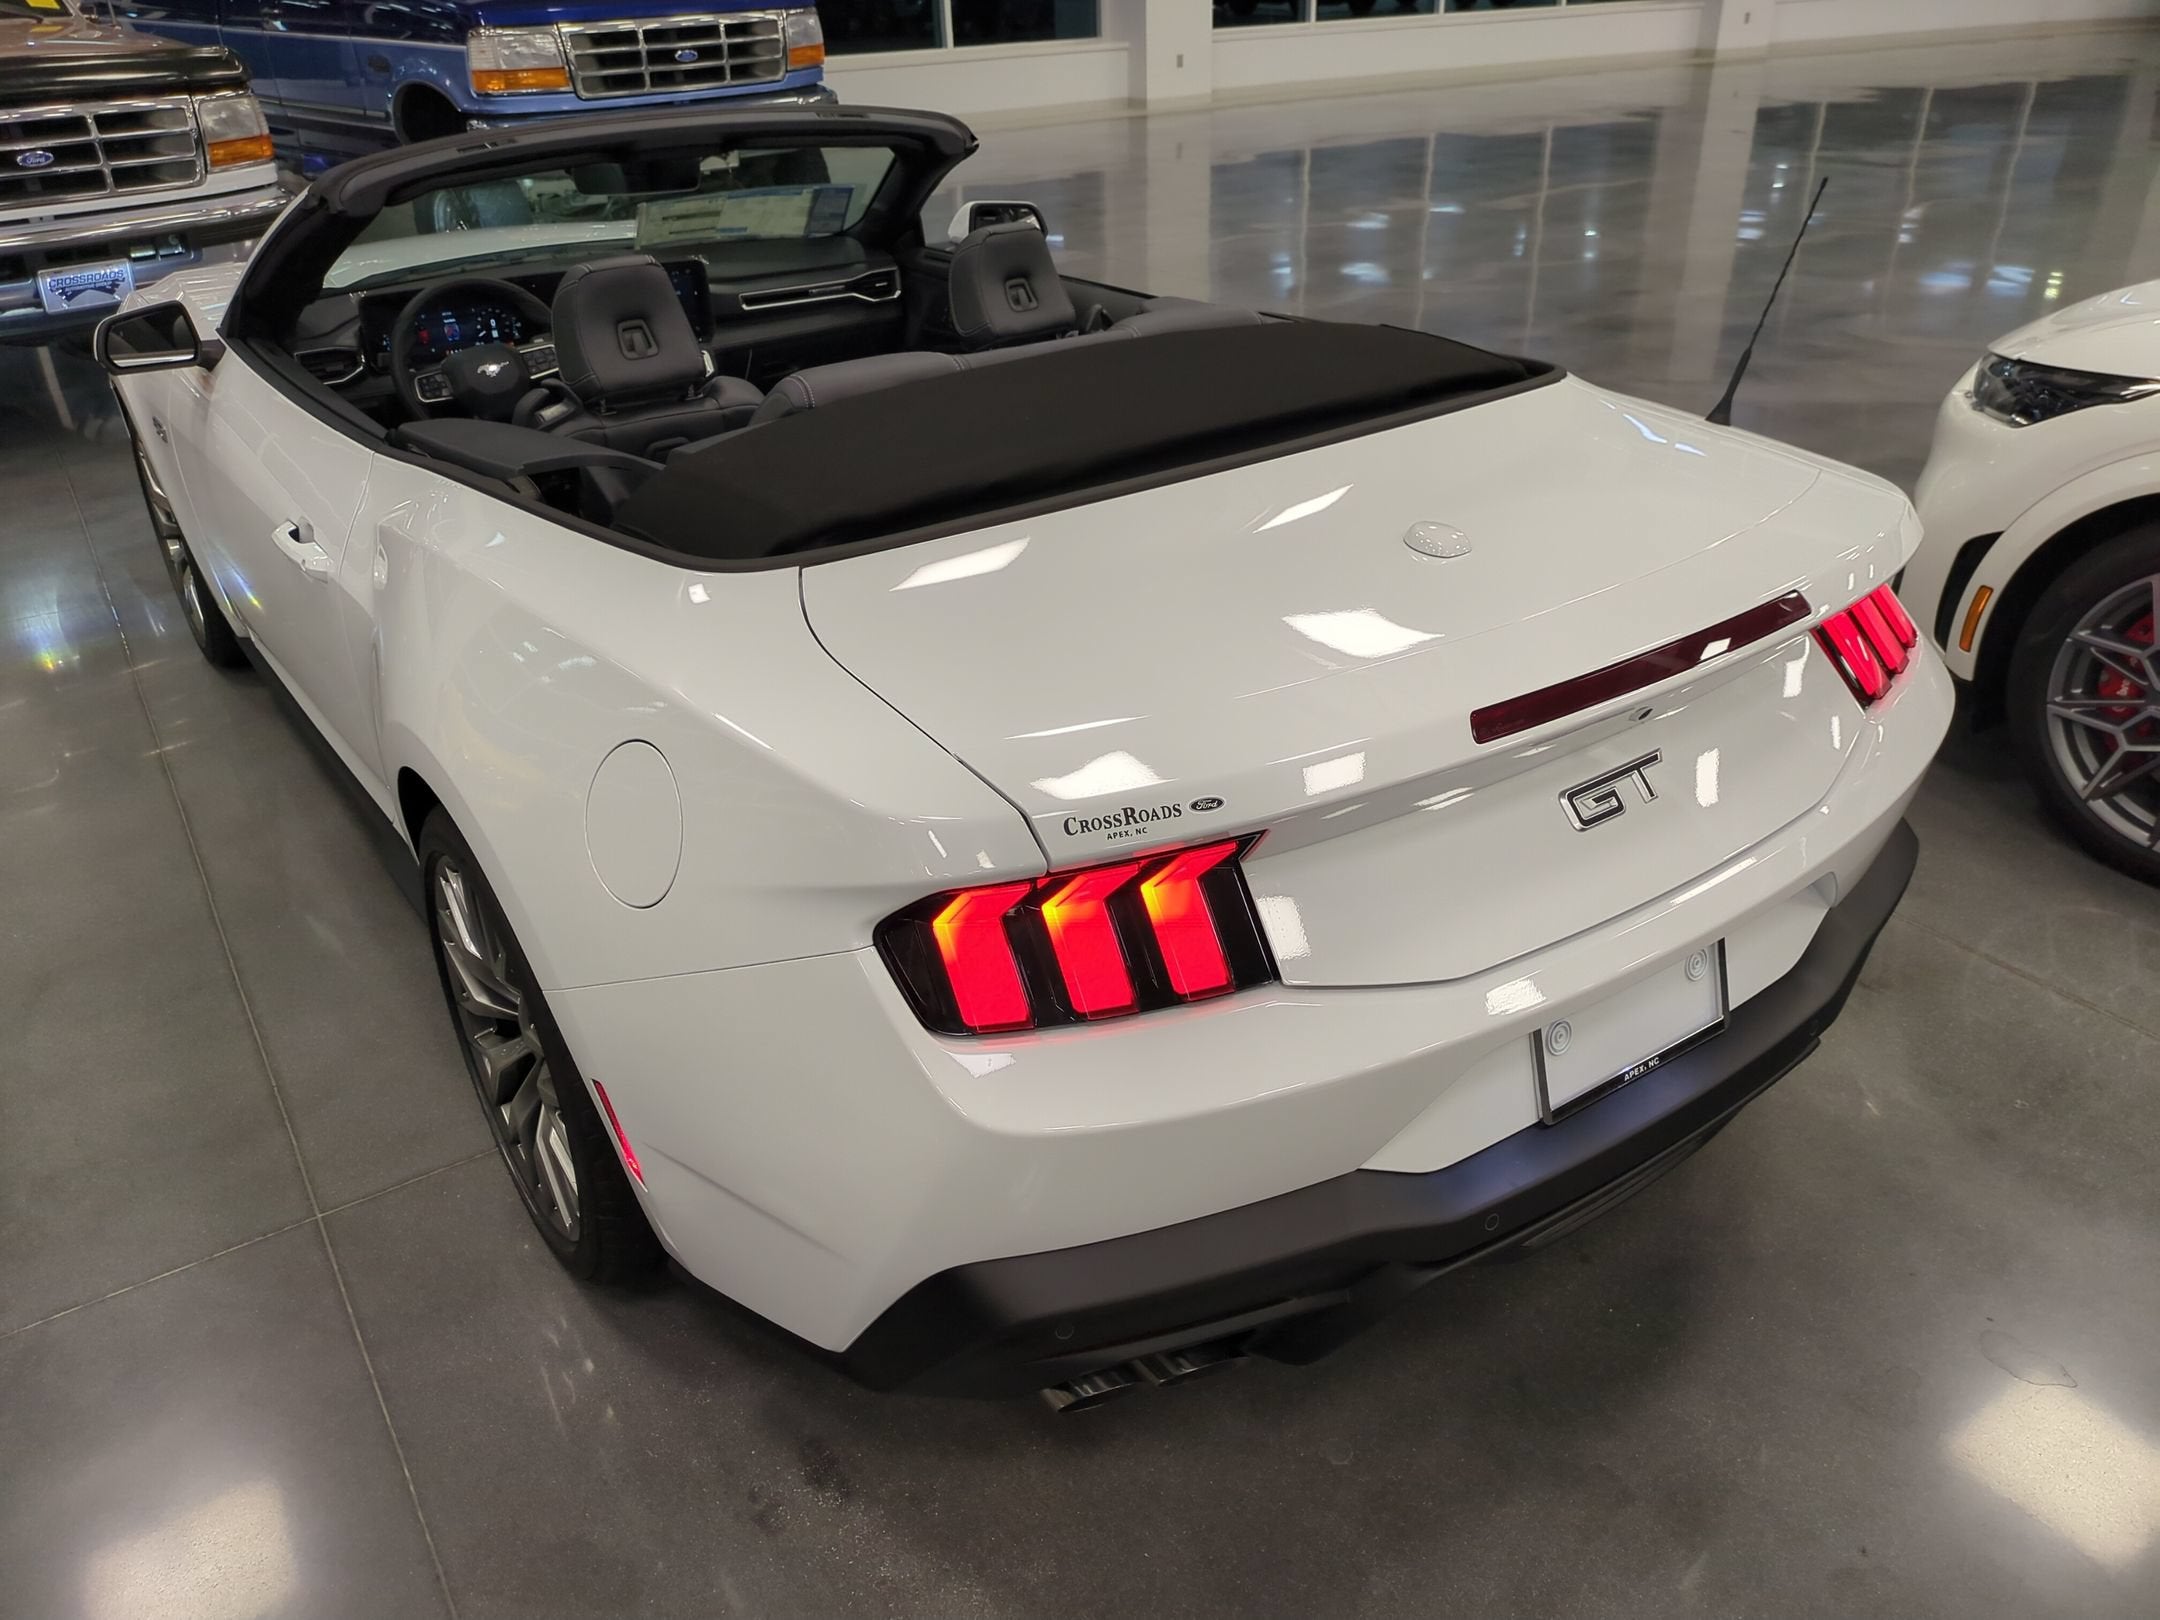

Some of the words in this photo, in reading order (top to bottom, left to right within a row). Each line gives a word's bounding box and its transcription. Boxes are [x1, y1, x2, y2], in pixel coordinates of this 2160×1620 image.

[49, 269, 124, 289] CROSSROADS
[1558, 747, 1663, 832] GT
[1107, 829, 1133, 840] APEX,
[1136, 827, 1148, 835] NC
[1624, 1065, 1647, 1082] APEX,
[1648, 1057, 1660, 1069] NC
